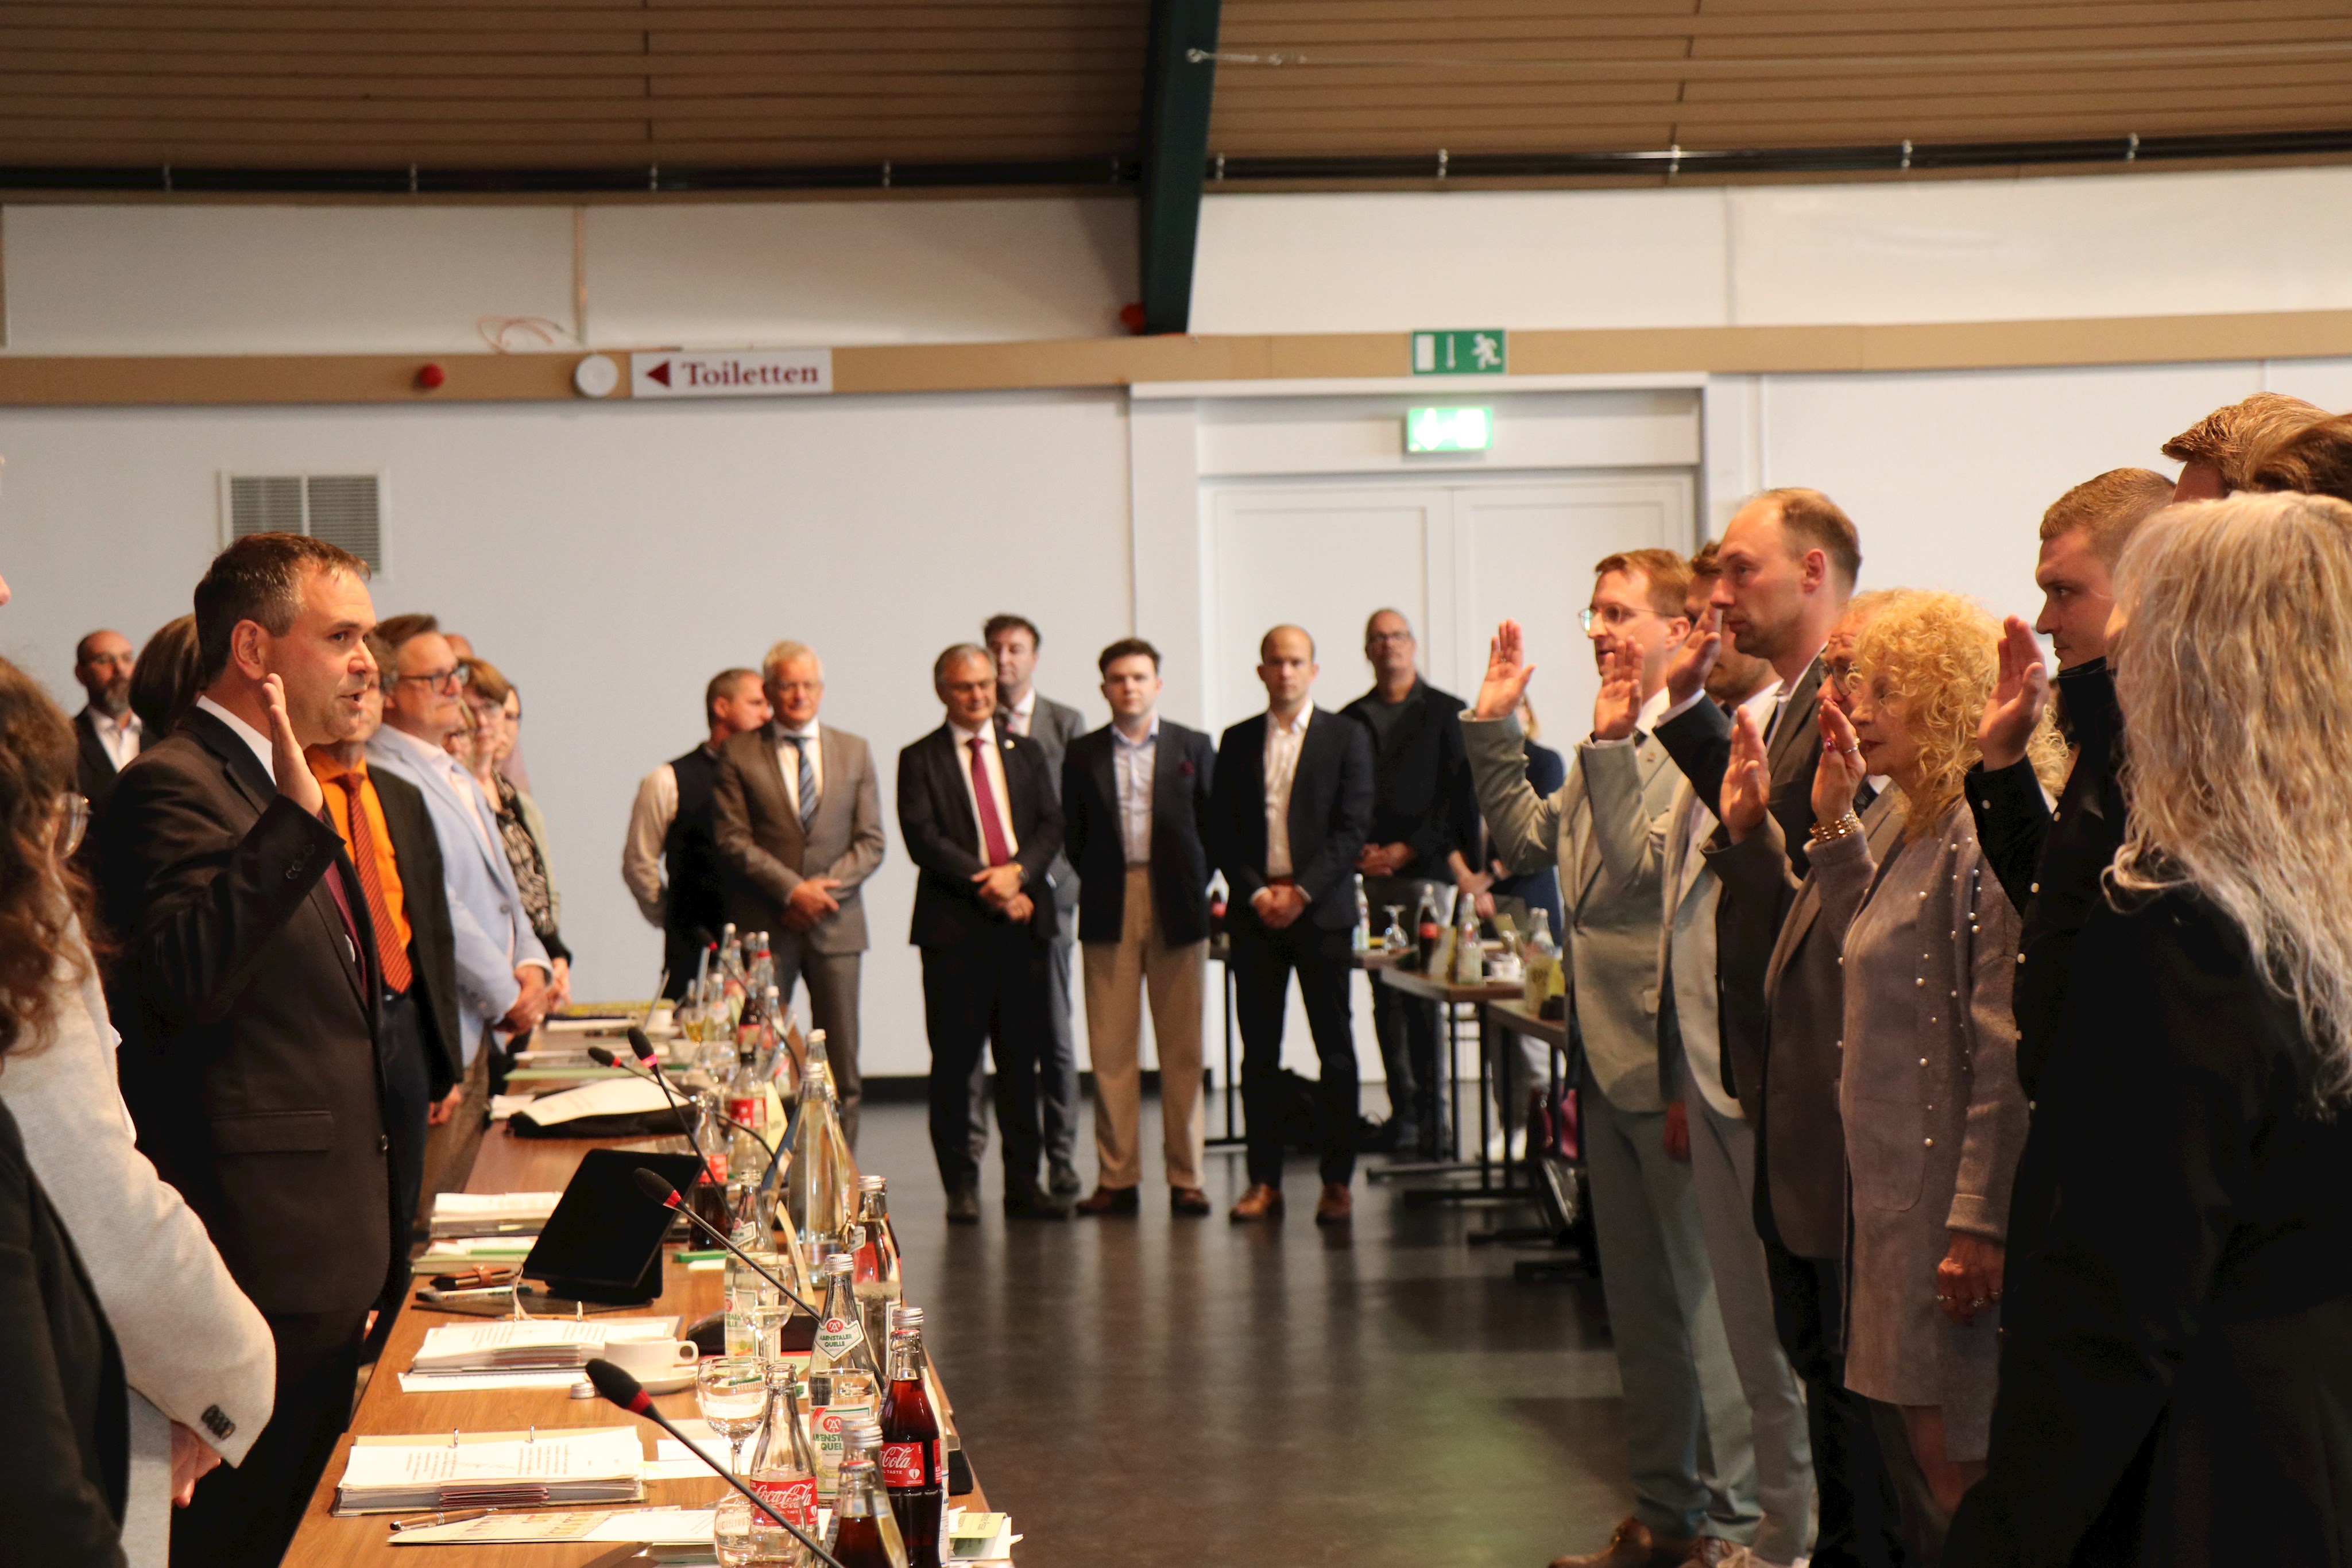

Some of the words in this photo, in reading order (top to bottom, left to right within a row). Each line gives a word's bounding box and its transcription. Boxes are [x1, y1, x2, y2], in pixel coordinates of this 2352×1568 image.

[681, 360, 819, 386] Toiletten
[812, 1434, 842, 1442] ABENST
[821, 1442, 843, 1451] QUEL
